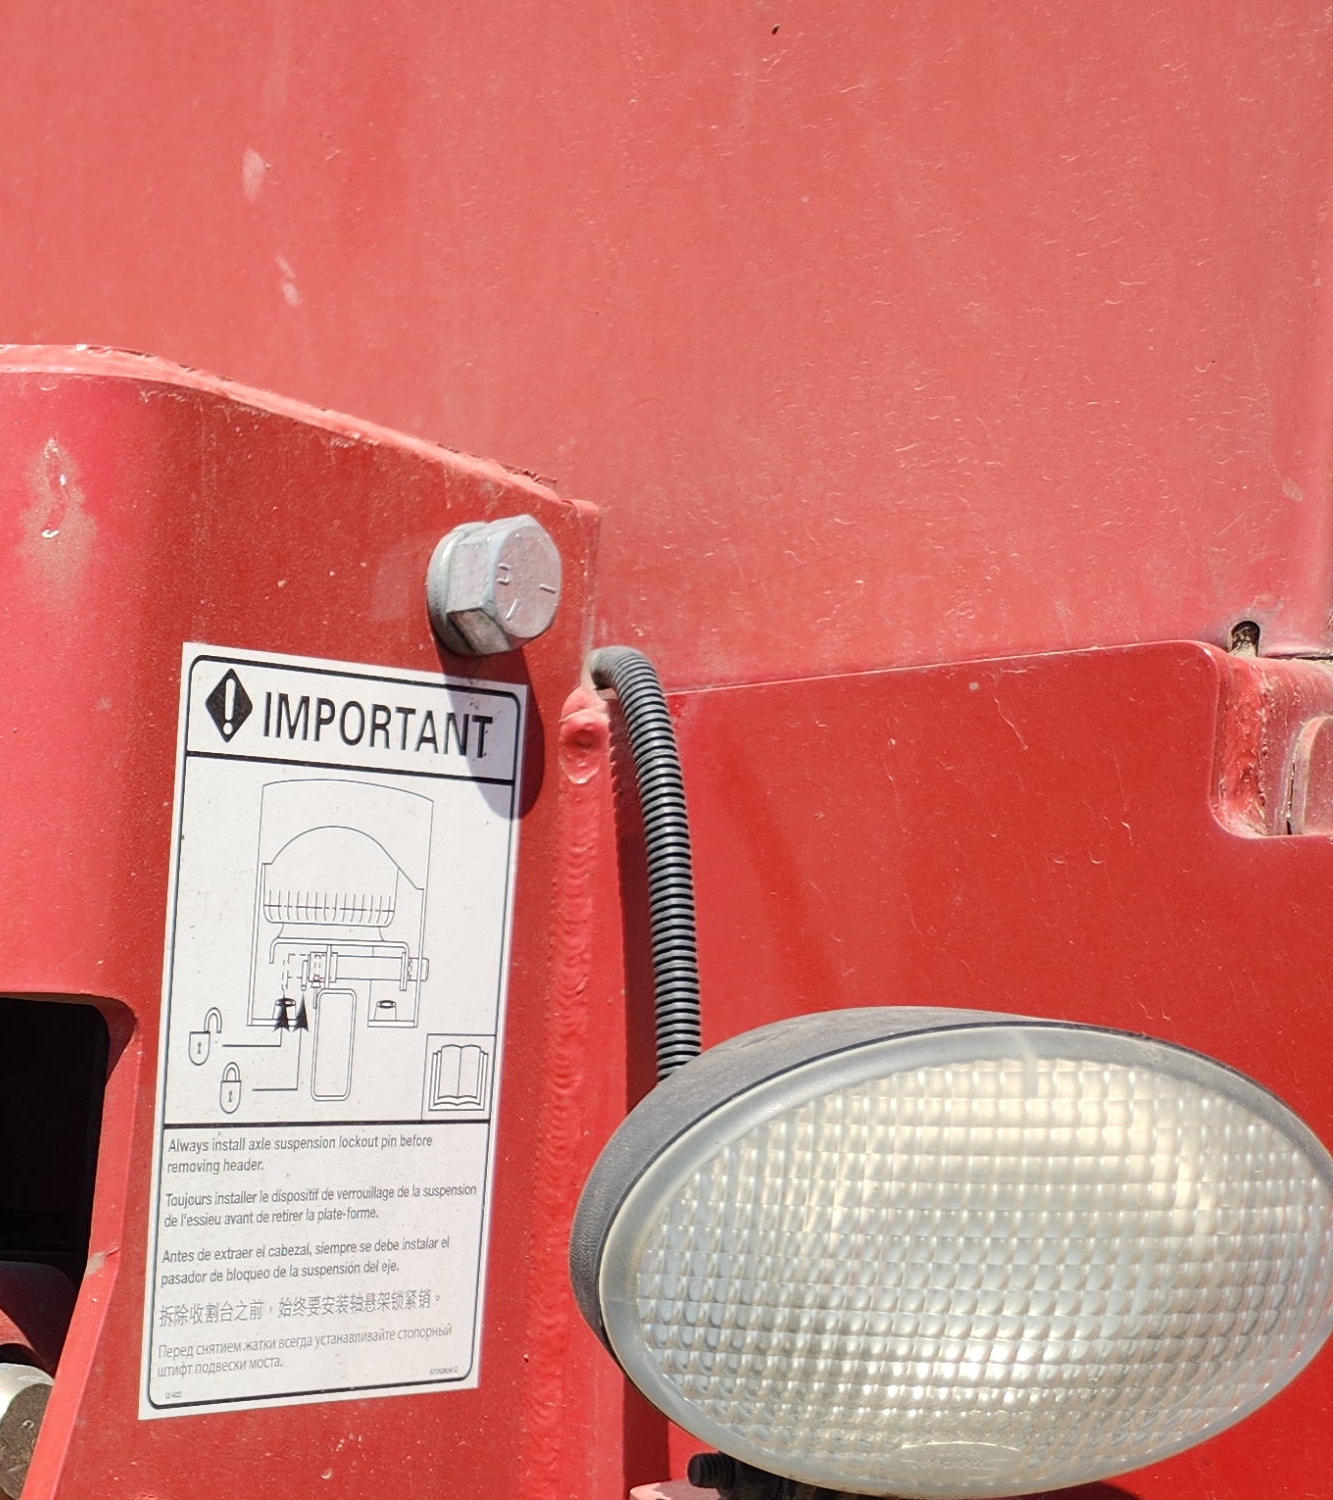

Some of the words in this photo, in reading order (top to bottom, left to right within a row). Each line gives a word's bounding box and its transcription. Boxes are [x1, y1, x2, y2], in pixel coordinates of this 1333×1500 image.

[264, 692, 493, 758] IMPORTANT
[168, 1138, 209, 1155] Always
[212, 1137, 246, 1151] install
[249, 1136, 271, 1151] axle
[274, 1135, 336, 1152] suspension
[338, 1134, 378, 1148] lockout
[381, 1133, 397, 1150] pin
[400, 1133, 433, 1147] before
[167, 1158, 220, 1175] removing
[223, 1158, 264, 1172] header.
[166, 1192, 212, 1209] Toujours
[215, 1190, 257, 1205] installer
[259, 1190, 269, 1203] le
[272, 1188, 319, 1205] dispositif
[321, 1187, 334, 1201] de
[337, 1185, 395, 1201] verrouillage
[397, 1185, 410, 1198] de
[412, 1184, 420, 1197] la
[423, 1183, 477, 1199] suspension
[164, 1214, 177, 1228] de
[180, 1212, 221, 1227] l'essieu
[224, 1212, 253, 1225] avant
[256, 1210, 269, 1223] de
[272, 1209, 303, 1223] retirer
[306, 1208, 314, 1221] la
[317, 1207, 379, 1224] plate-forme.
[161, 1249, 194, 1263] Antes
[198, 1248, 211, 1261] de
[214, 1247, 253, 1261] extraer
[256, 1245, 265, 1258] el
[268, 1242, 312, 1257] cabezal,
[315, 1241, 357, 1257] siempre
[359, 1242, 372, 1253] se
[374, 1239, 399, 1252] debe
[402, 1236, 439, 1250] instalar
[441, 1235, 450, 1249] el
[161, 1270, 207, 1288] pasador
[210, 1268, 223, 1282] de
[226, 1268, 270, 1283] bloqueo
[273, 1265, 286, 1279] de
[289, 1264, 299, 1277] la
[302, 1259, 360, 1278] suspensión
[363, 1259, 379, 1273] del
[381, 1259, 399, 1275] eje.
[158, 1344, 193, 1360] Перед
[196, 1340, 241, 1356] снятием
[243, 1338, 276, 1352] жатки
[278, 1335, 312, 1350] всегда
[315, 1328, 396, 1350] устанавливайте
[397, 1323, 452, 1341] стопорный
[157, 1361, 193, 1378] штифт
[194, 1358, 246, 1375] подвески
[249, 1356, 282, 1370] моста.
